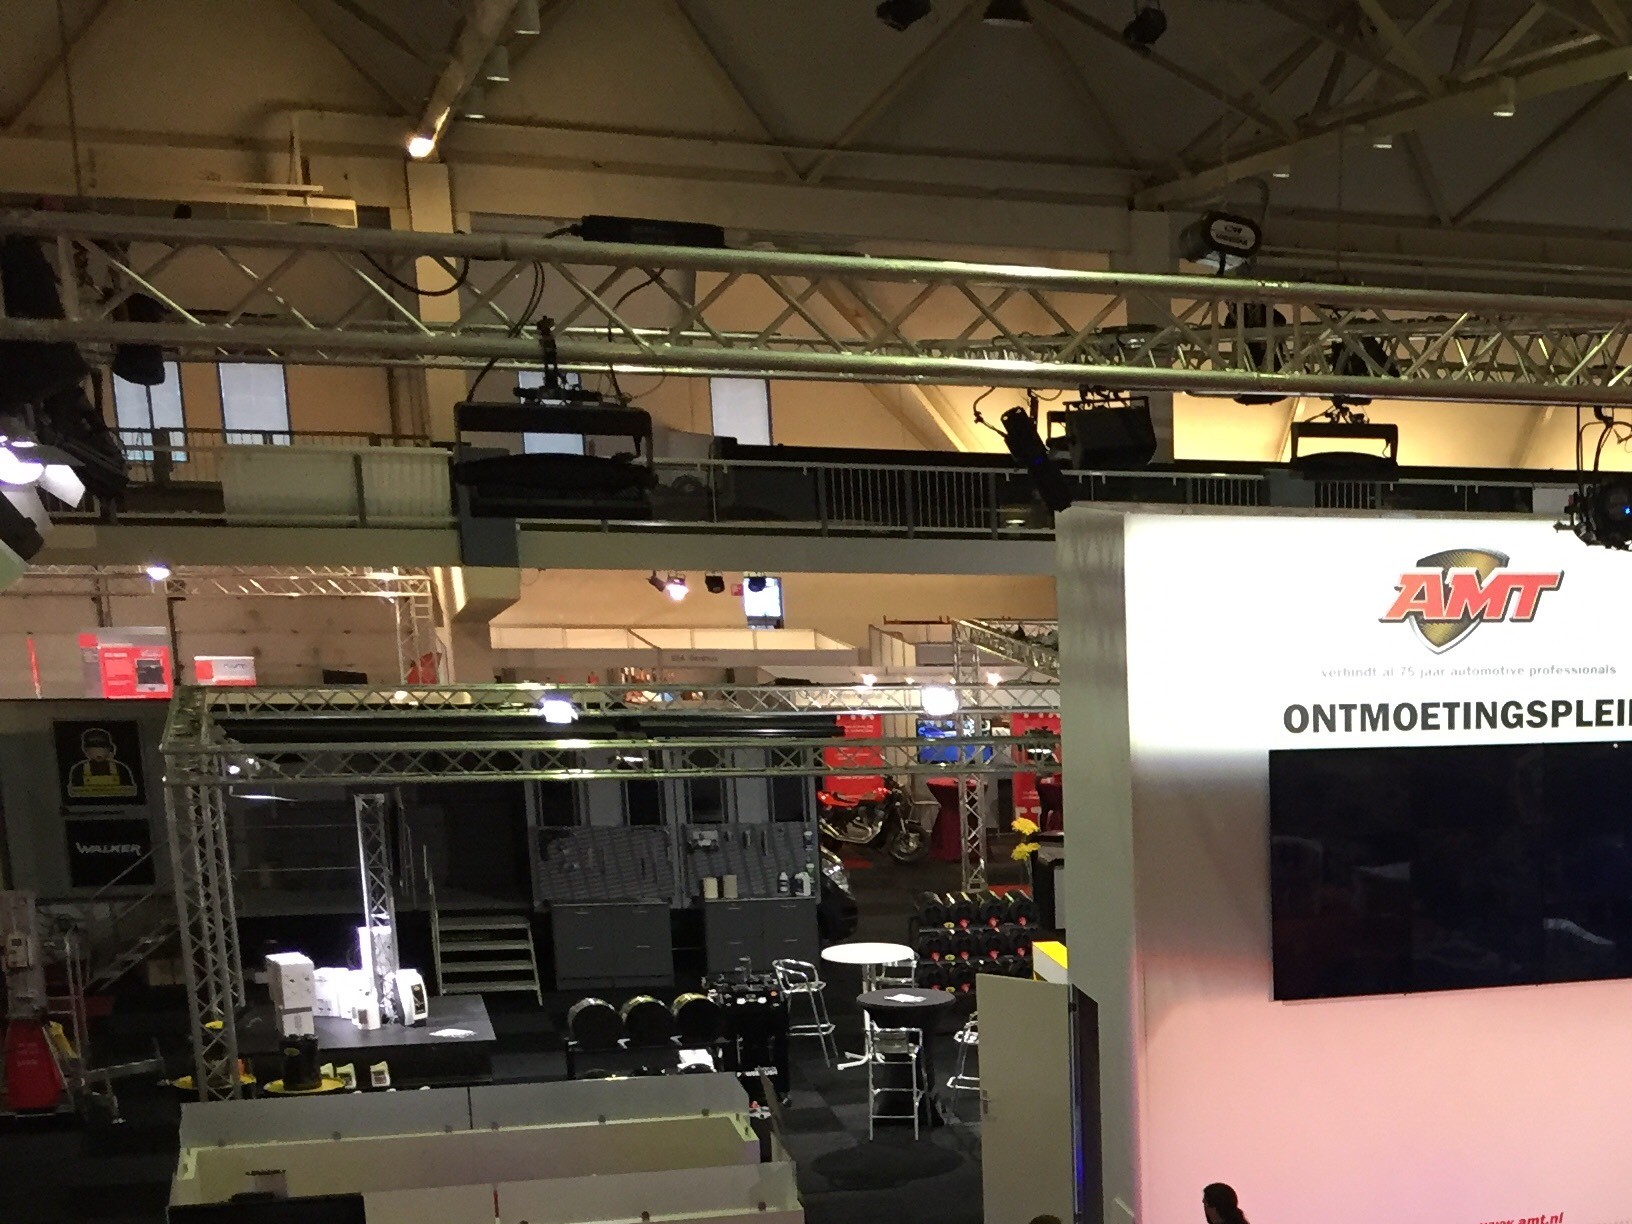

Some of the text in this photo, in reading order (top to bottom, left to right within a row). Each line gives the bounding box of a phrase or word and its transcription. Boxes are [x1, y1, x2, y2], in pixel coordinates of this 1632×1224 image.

[1378, 567, 1565, 623] AMT
[1321, 663, 1617, 680] verbindt al 75 jaar automotive professionals
